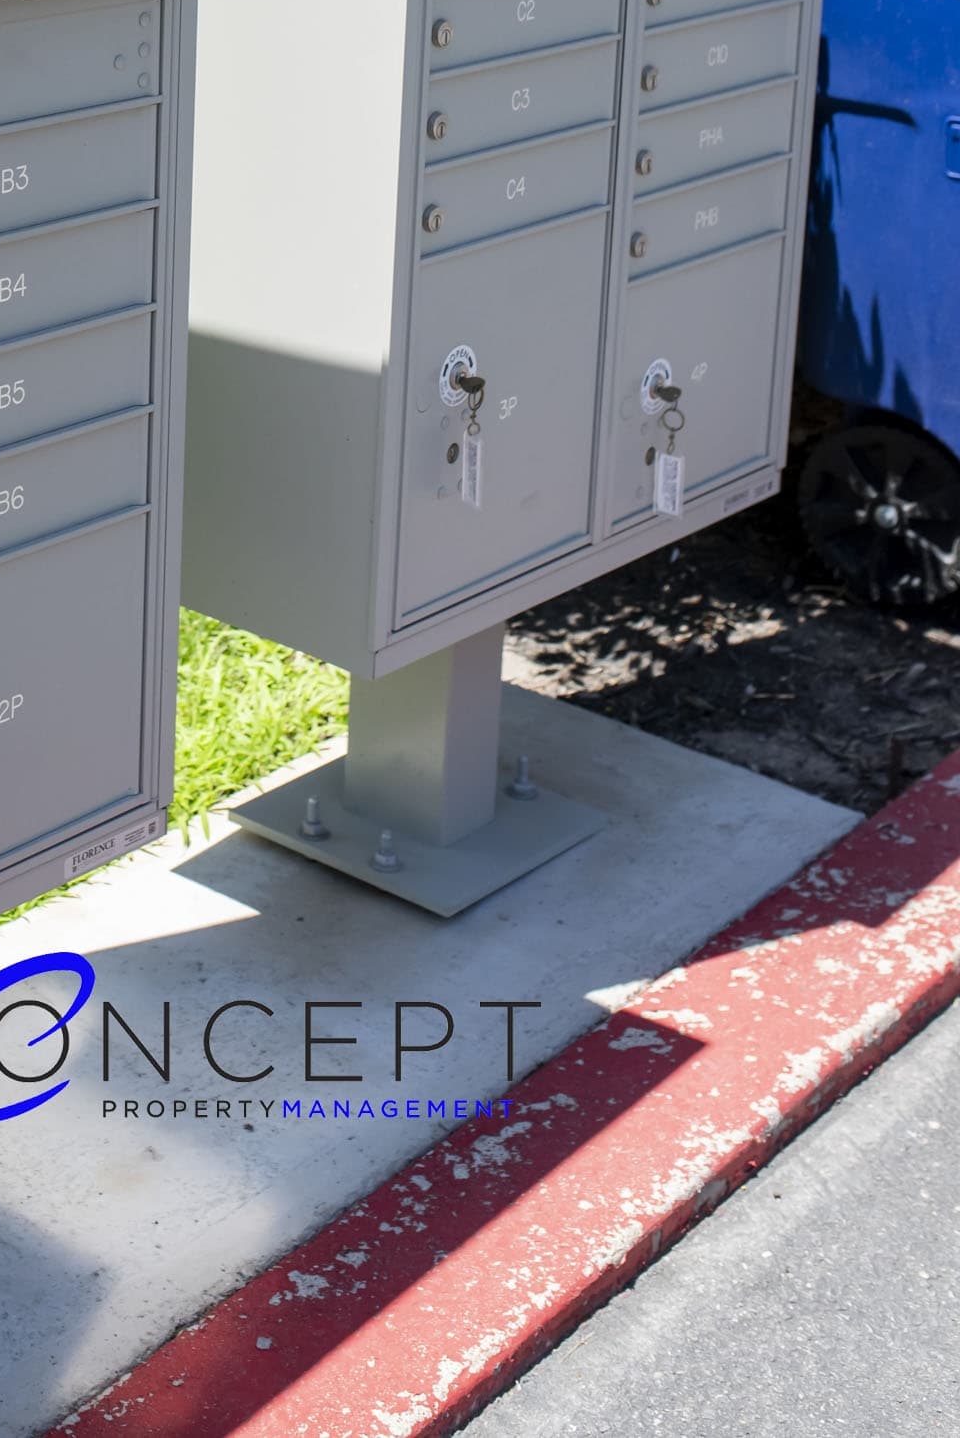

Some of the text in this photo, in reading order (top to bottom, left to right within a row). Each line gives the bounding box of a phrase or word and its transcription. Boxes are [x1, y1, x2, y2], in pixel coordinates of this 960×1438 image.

[517, 0, 535, 21] C2
[708, 44, 728, 66] C10
[512, 88, 530, 111] C3
[699, 127, 723, 148] PHA
[2, 165, 28, 194] B3
[507, 177, 525, 199] C4
[0, 274, 26, 302] B4
[449, 348, 470, 363] OPEN
[0, 380, 25, 409] B5
[72, 837, 115, 866] FLORENCE
